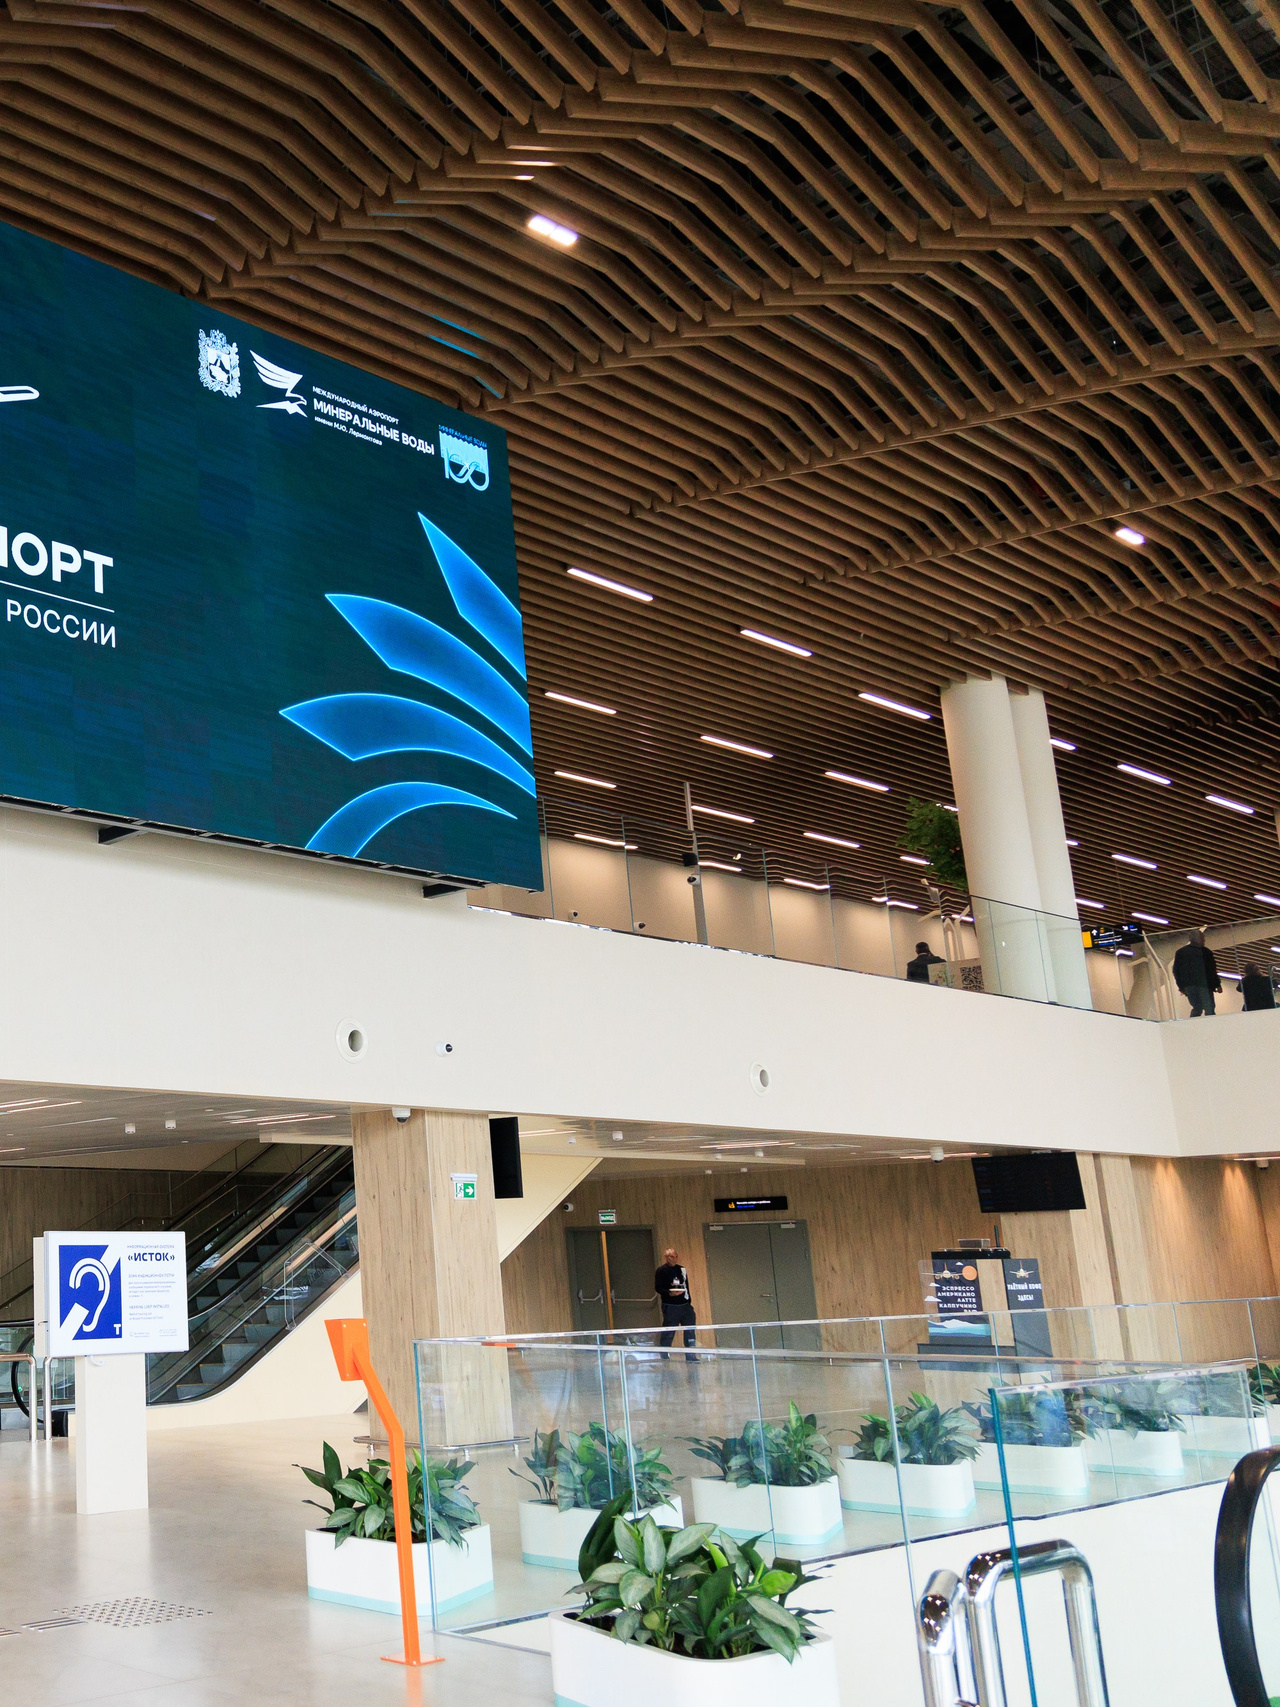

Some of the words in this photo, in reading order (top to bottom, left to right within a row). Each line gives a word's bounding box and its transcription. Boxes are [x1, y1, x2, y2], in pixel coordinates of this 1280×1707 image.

[312, 385, 368, 412] МЕЖДУНАРОДНЫЙ
[368, 408, 399, 425] АЭРОПОРТ
[313, 398, 400, 442] МИНЕРАЛЬНЫЕ
[401, 432, 435, 455] ВОДЫ
[314, 416, 333, 428] имени
[348, 427, 383, 446] Лермонтова
[6, 598, 116, 648] РОССИИ
[128, 1252, 175, 1262] «ИСТОК»
